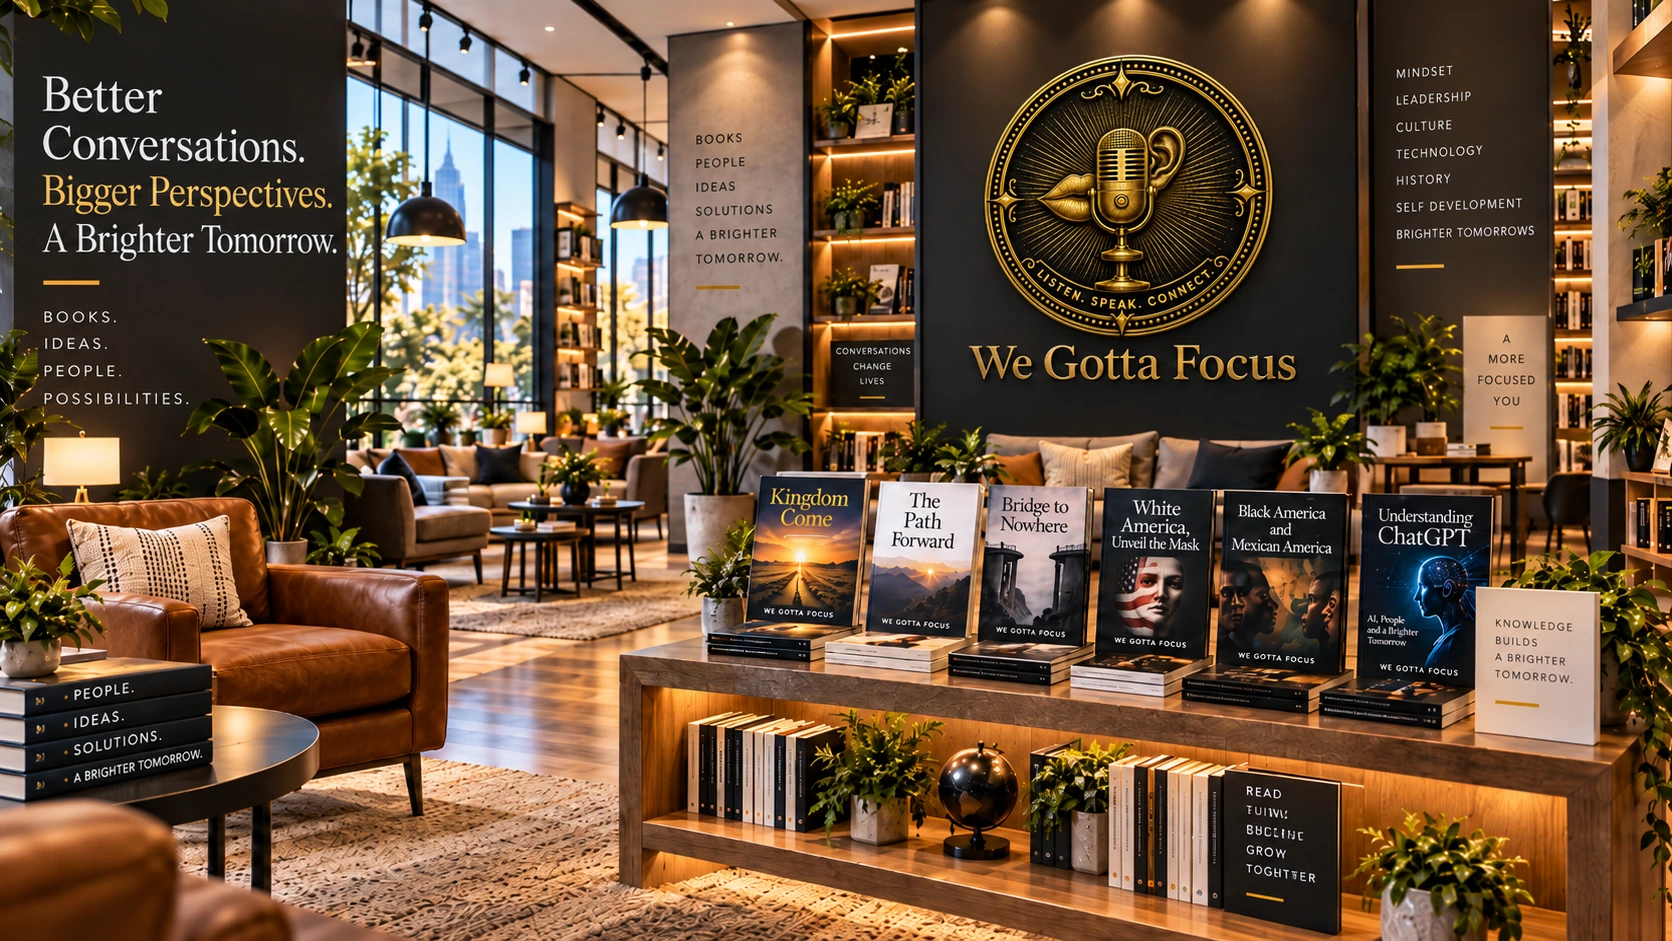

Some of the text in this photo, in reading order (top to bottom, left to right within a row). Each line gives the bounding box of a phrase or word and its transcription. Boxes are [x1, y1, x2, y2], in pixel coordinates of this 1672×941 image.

[1397, 66, 1452, 78] MINDSET
[43, 76, 162, 113] Better
[1397, 91, 1471, 105] LEADERSHIP
[1396, 120, 1451, 132] CULTURE
[43, 125, 304, 163] Conversations.
[696, 133, 742, 145] BOOKS
[1396, 145, 1482, 159] TECHNOLOGY
[696, 157, 745, 168] PEOPLE
[1397, 174, 1450, 185] HISTORY
[696, 181, 735, 192] IDEAS
[43, 175, 332, 216] Bigger Perspectives.
[696, 204, 772, 216] SOLUTIONS
[1397, 198, 1522, 212] SELF DEVELOPMENT
[696, 228, 776, 240] A BRIGHTER
[1397, 226, 1534, 239] BRIGHTER TOMORROWS
[43, 223, 337, 261] A Brighter Tomorrow.
[696, 253, 782, 264] TOMORROW.
[1036, 268, 1215, 310] LISTEN. SPEAK. CONNECT.
[44, 311, 116, 323] BOOKS.
[45, 338, 107, 349] IDEAS.
[1503, 335, 1510, 343] A
[969, 345, 1296, 380] We Gotta Focus
[1489, 354, 1524, 363] MORE
[44, 365, 121, 377] PEOPLE.
[1478, 375, 1535, 385] FOCUSED
[44, 393, 188, 405] POSSIBILITIES.
[1494, 396, 1519, 406] YOU
[770, 488, 848, 510] Kingdom
[910, 492, 940, 508] The
[1001, 497, 1068, 517] Bridge to
[1133, 500, 1180, 516] White
[1239, 505, 1326, 519] Black America
[780, 508, 833, 528] Come
[905, 512, 941, 529] Path
[1001, 515, 1068, 533] Nowhere
[1379, 509, 1473, 528] Understanding
[1120, 518, 1190, 537] America,
[1270, 523, 1291, 535] and
[892, 532, 954, 549] Forward
[1379, 525, 1472, 547] ChatGPT
[1112, 536, 1199, 550] Unveil the Mask
[1232, 538, 1331, 554] Mexican America
[924, 621, 949, 629] FOCUS
[1381, 615, 1405, 626] People
[1496, 619, 1572, 632] KNOWLEDGE
[1496, 636, 1537, 647] BUILDS
[1254, 653, 1281, 661] GOTTA
[1286, 656, 1314, 664] FOCUS
[1495, 653, 1565, 665] A BRIGHTER
[1396, 665, 1424, 673] GOTTA
[1429, 668, 1458, 676] FOCUS
[1495, 670, 1572, 683] TOMORROW.
[74, 683, 134, 700] PEOPLE.
[75, 711, 124, 728] IDEAS.
[74, 731, 161, 755] SOLUTIONS.
[74, 749, 202, 783] A BRIGHTER TOMORROW.
[1247, 786, 1281, 798] READ
[1247, 845, 1286, 858] GROW
